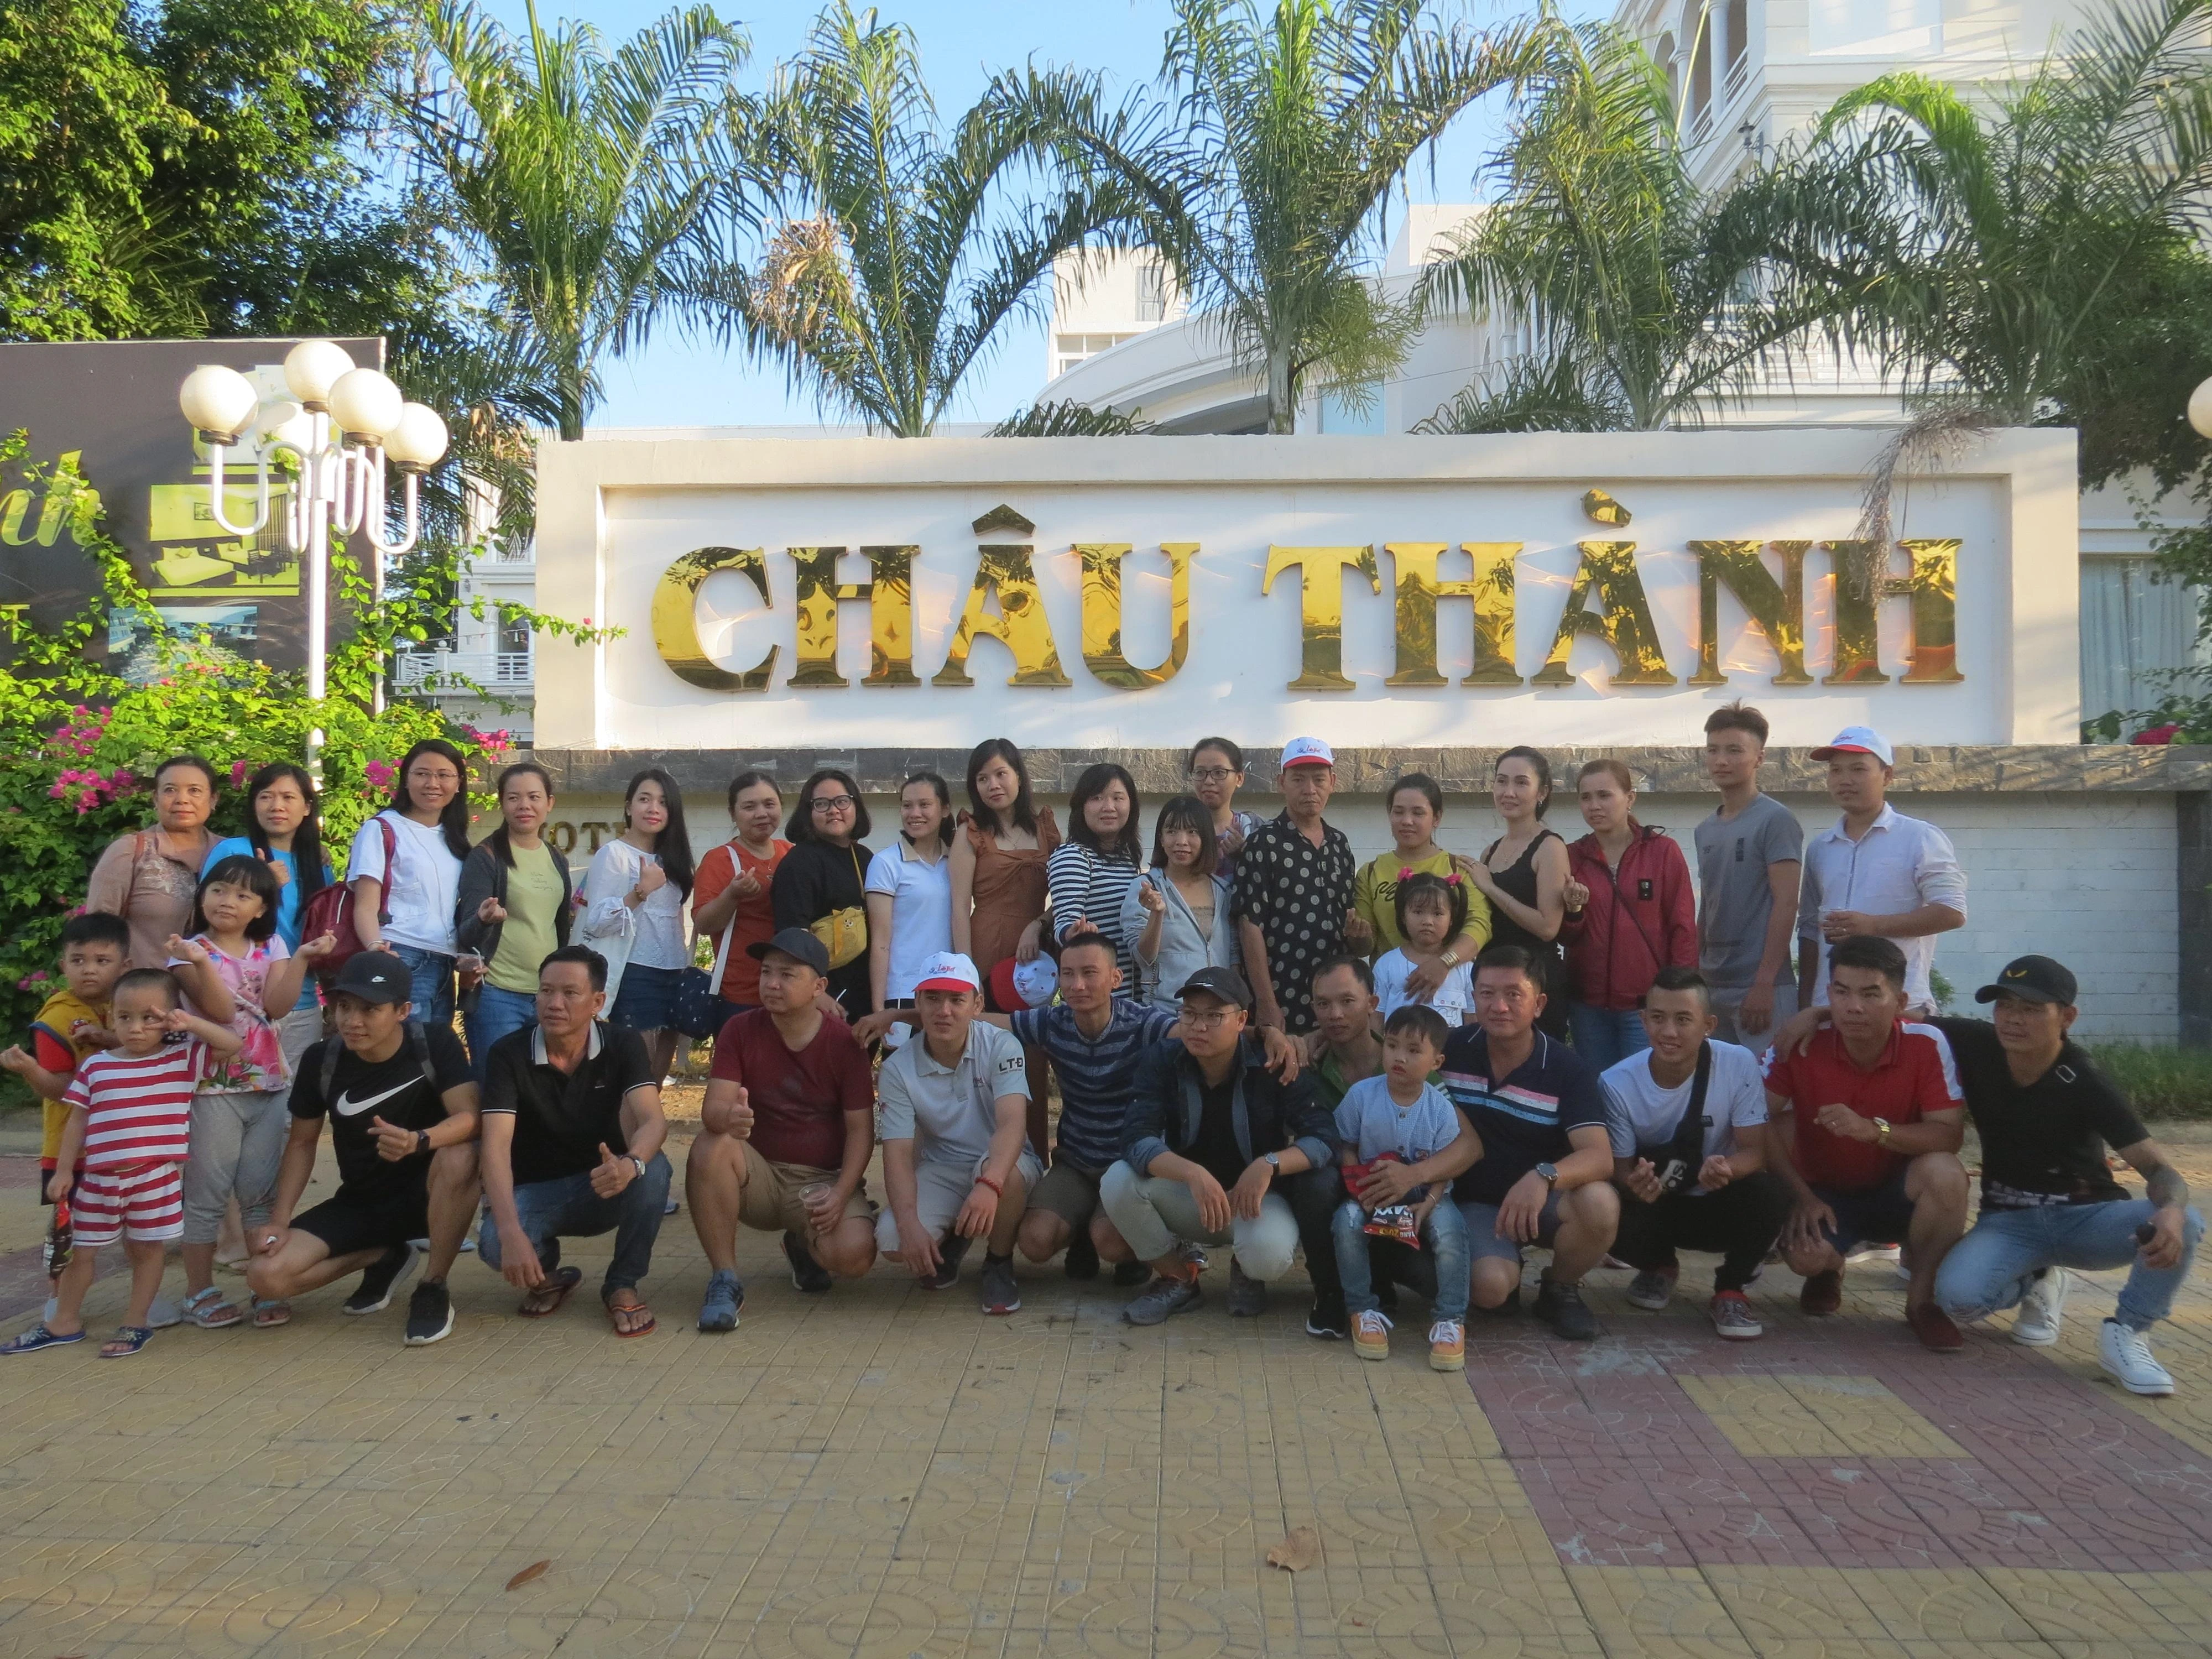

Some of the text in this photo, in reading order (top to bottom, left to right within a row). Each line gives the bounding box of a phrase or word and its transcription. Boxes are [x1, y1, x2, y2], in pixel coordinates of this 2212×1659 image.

[651, 489, 1964, 692] CHÂU THÀNH
[538, 821, 628, 854] OT
